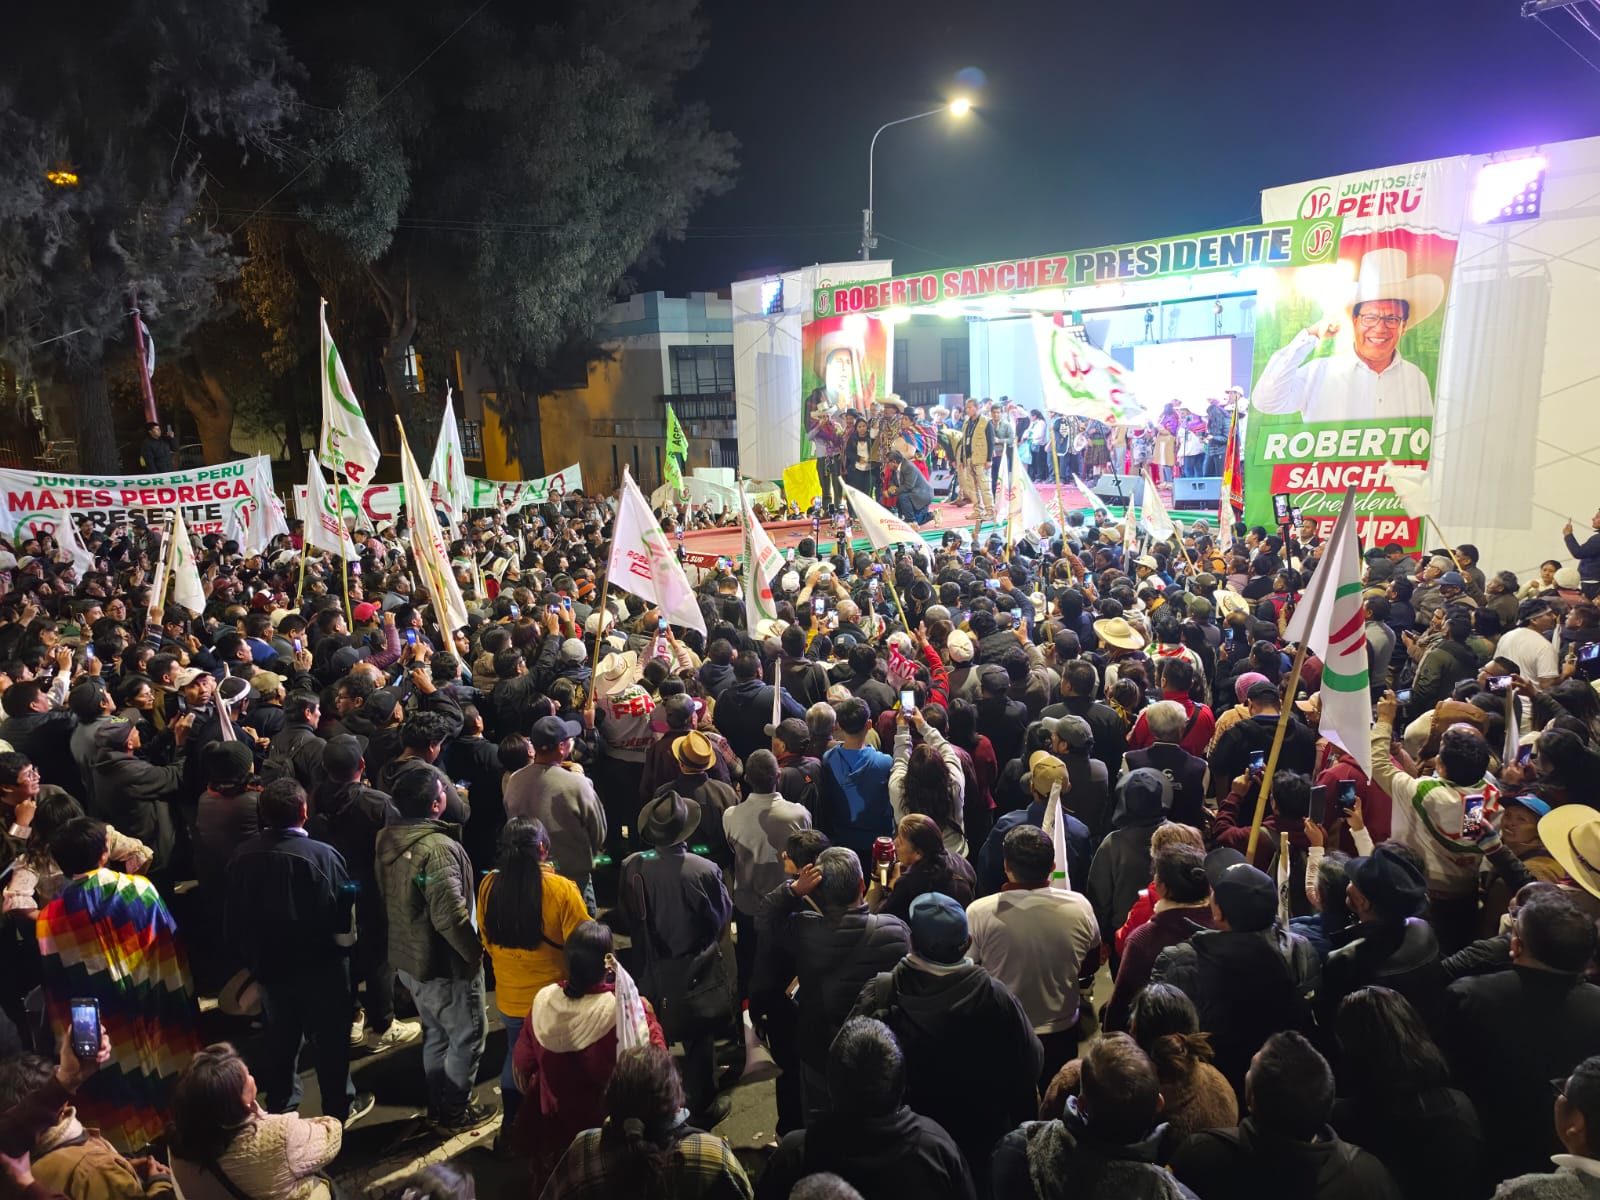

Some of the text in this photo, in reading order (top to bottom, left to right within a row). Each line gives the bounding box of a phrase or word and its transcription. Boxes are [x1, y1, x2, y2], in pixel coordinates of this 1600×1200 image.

[1341, 175, 1406, 197] JUNTOS
[834, 226, 1293, 313] ROBERTO SANCHEZ PRESIDENTE
[1264, 427, 1430, 460] ROBERTO
[8, 488, 112, 512] MAJES
[119, 478, 254, 507] PEDREGA
[33, 476, 117, 488] JUNTOS
[123, 477, 164, 488] POR
[170, 474, 192, 484] EL
